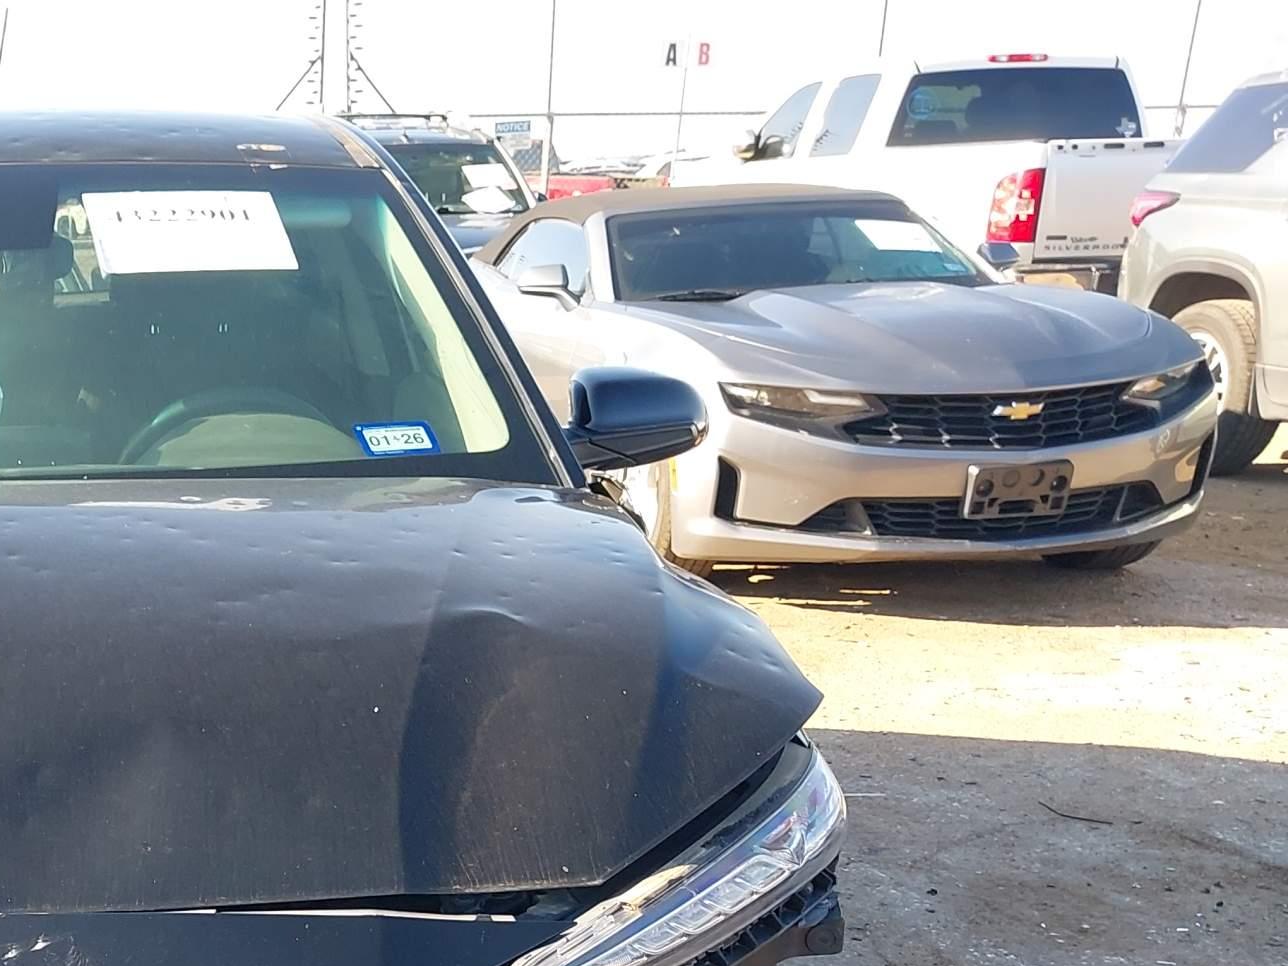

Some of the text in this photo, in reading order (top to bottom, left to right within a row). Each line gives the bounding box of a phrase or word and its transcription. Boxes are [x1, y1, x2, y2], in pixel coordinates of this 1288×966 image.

[665, 43, 677, 66] A
[698, 43, 710, 65] B
[496, 123, 529, 132] NOTICE
[401, 432, 425, 444] 26
